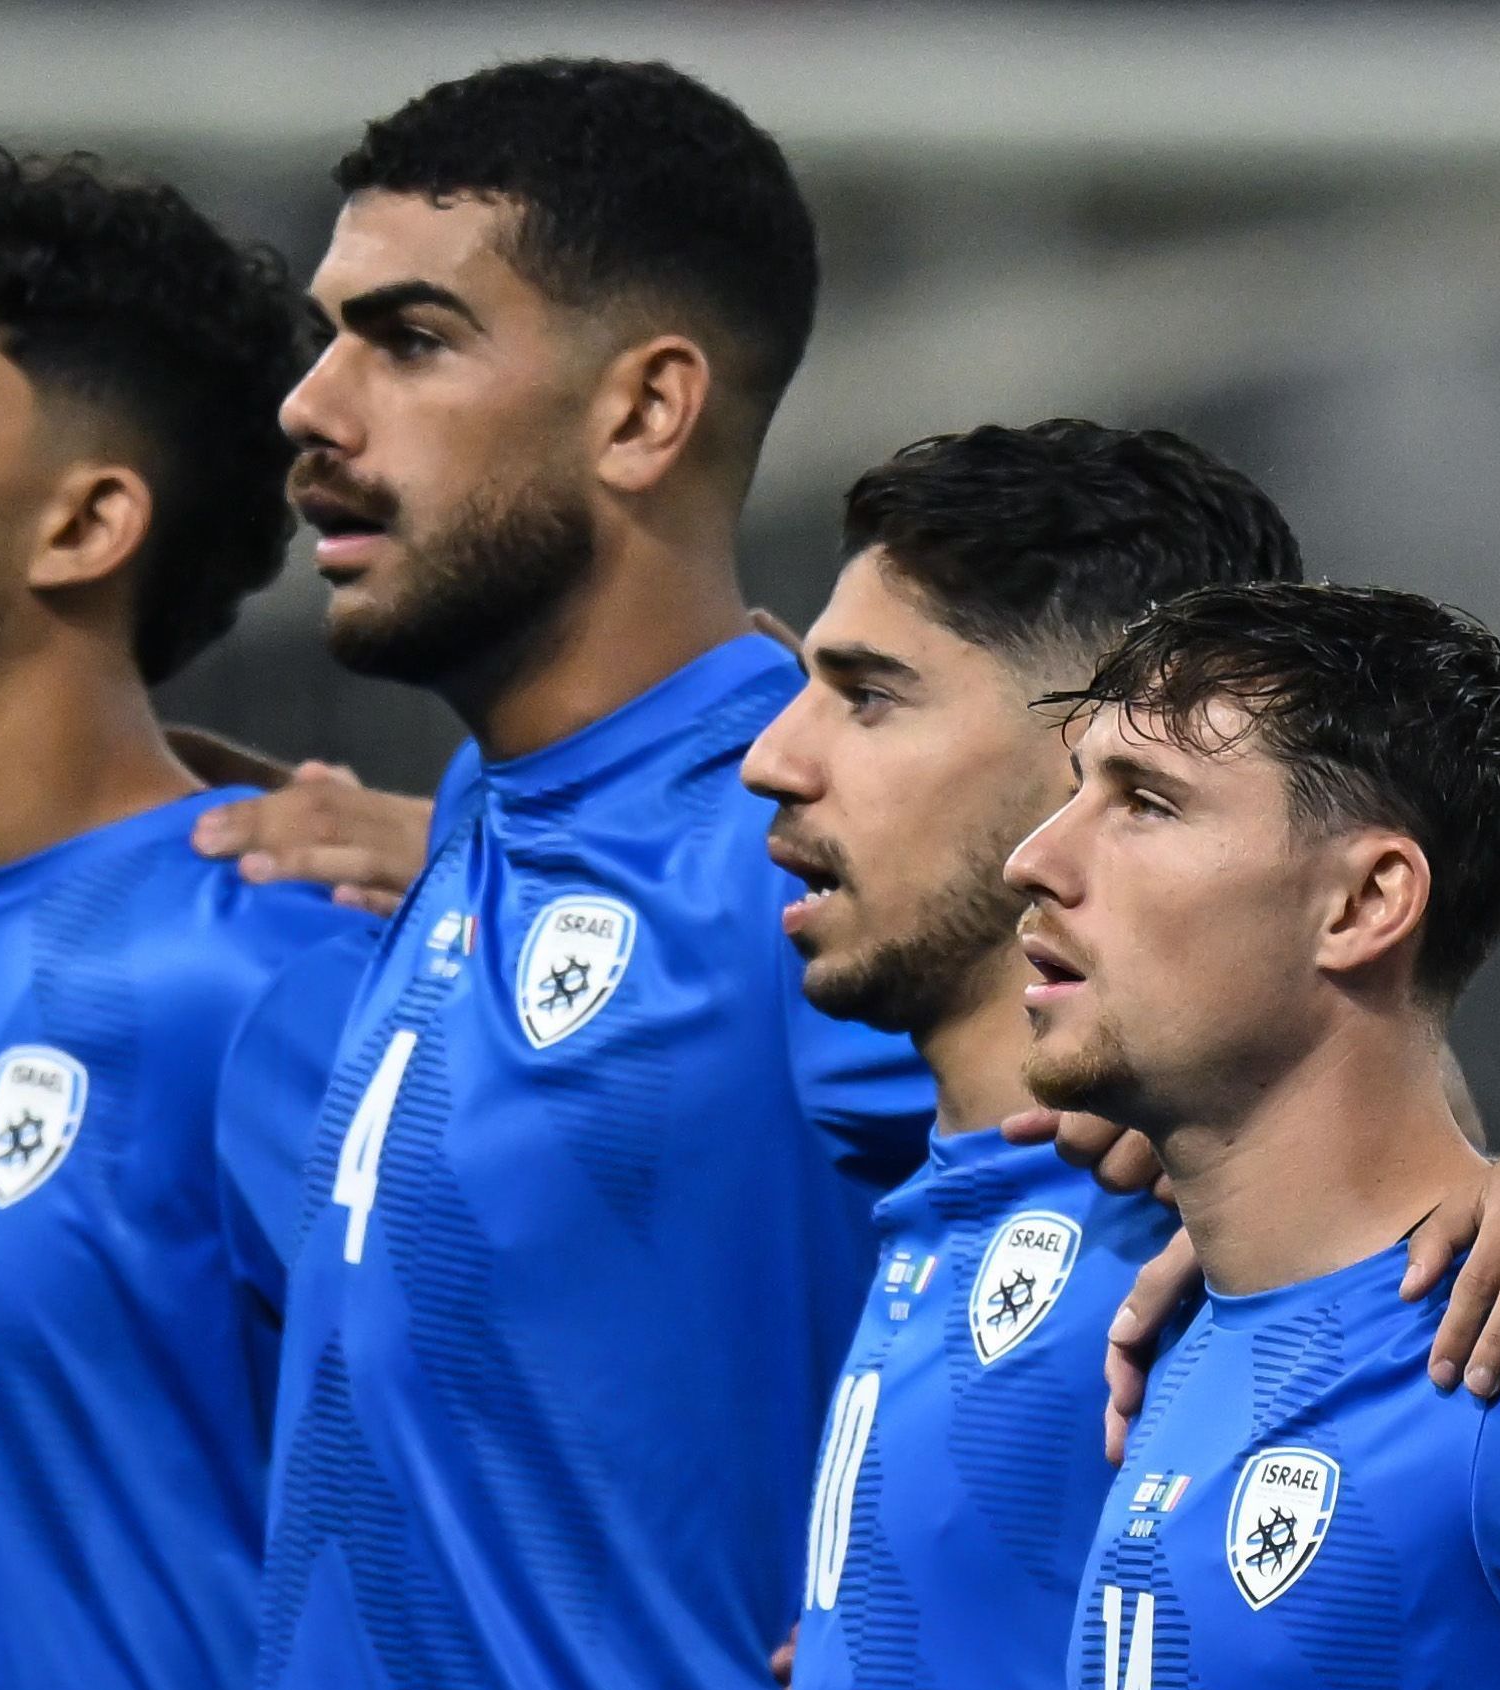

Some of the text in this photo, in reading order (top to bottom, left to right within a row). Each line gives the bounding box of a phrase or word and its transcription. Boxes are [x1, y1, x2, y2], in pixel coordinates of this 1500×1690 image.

[555, 912, 614, 940] ISRAEL
[332, 1028, 419, 1265] 4
[1008, 1228, 1062, 1254] ISRAEL
[1260, 1463, 1319, 1491] ISRAEL
